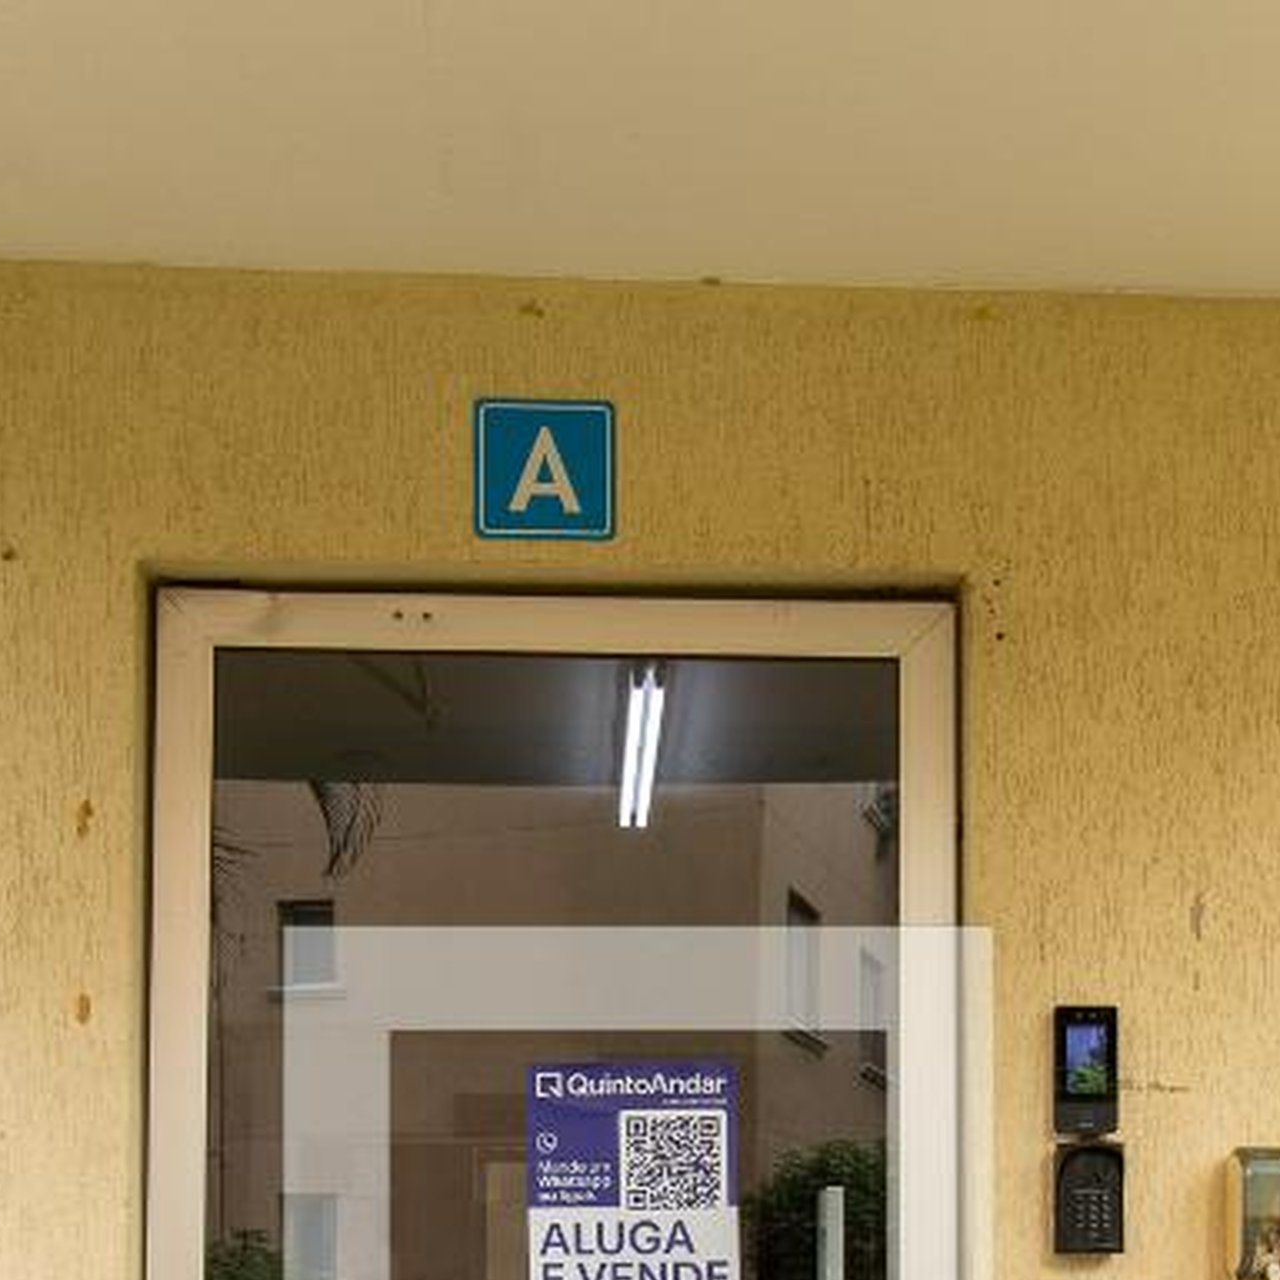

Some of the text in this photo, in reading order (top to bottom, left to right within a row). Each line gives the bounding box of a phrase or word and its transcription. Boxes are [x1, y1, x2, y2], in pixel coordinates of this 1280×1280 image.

[508, 426, 581, 514] A
[566, 1073, 727, 1096] QuintoAndar
[540, 1220, 695, 1254] ALUGA
